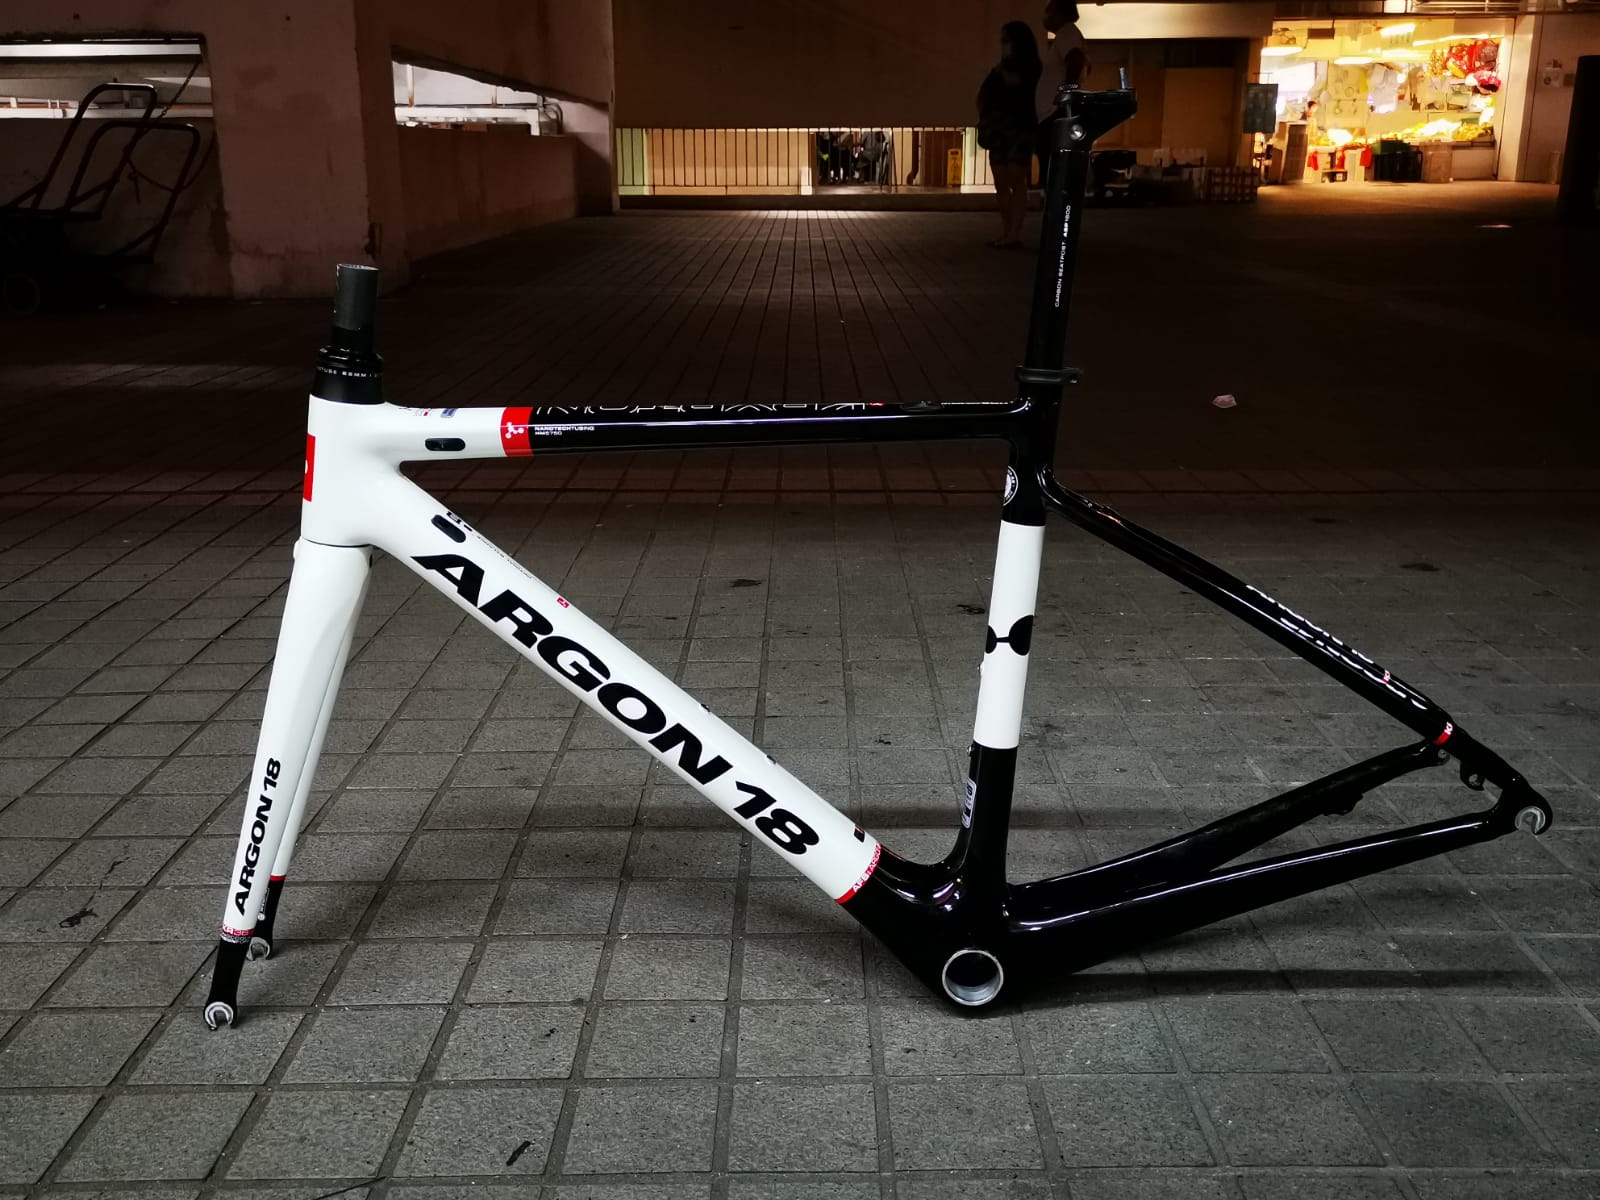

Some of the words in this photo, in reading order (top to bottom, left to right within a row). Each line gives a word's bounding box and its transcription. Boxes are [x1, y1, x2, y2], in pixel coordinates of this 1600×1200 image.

[410, 554, 733, 785] ARGON
[733, 781, 820, 855] 18
[235, 795, 273, 915] ARGON
[264, 757, 281, 791] 18
